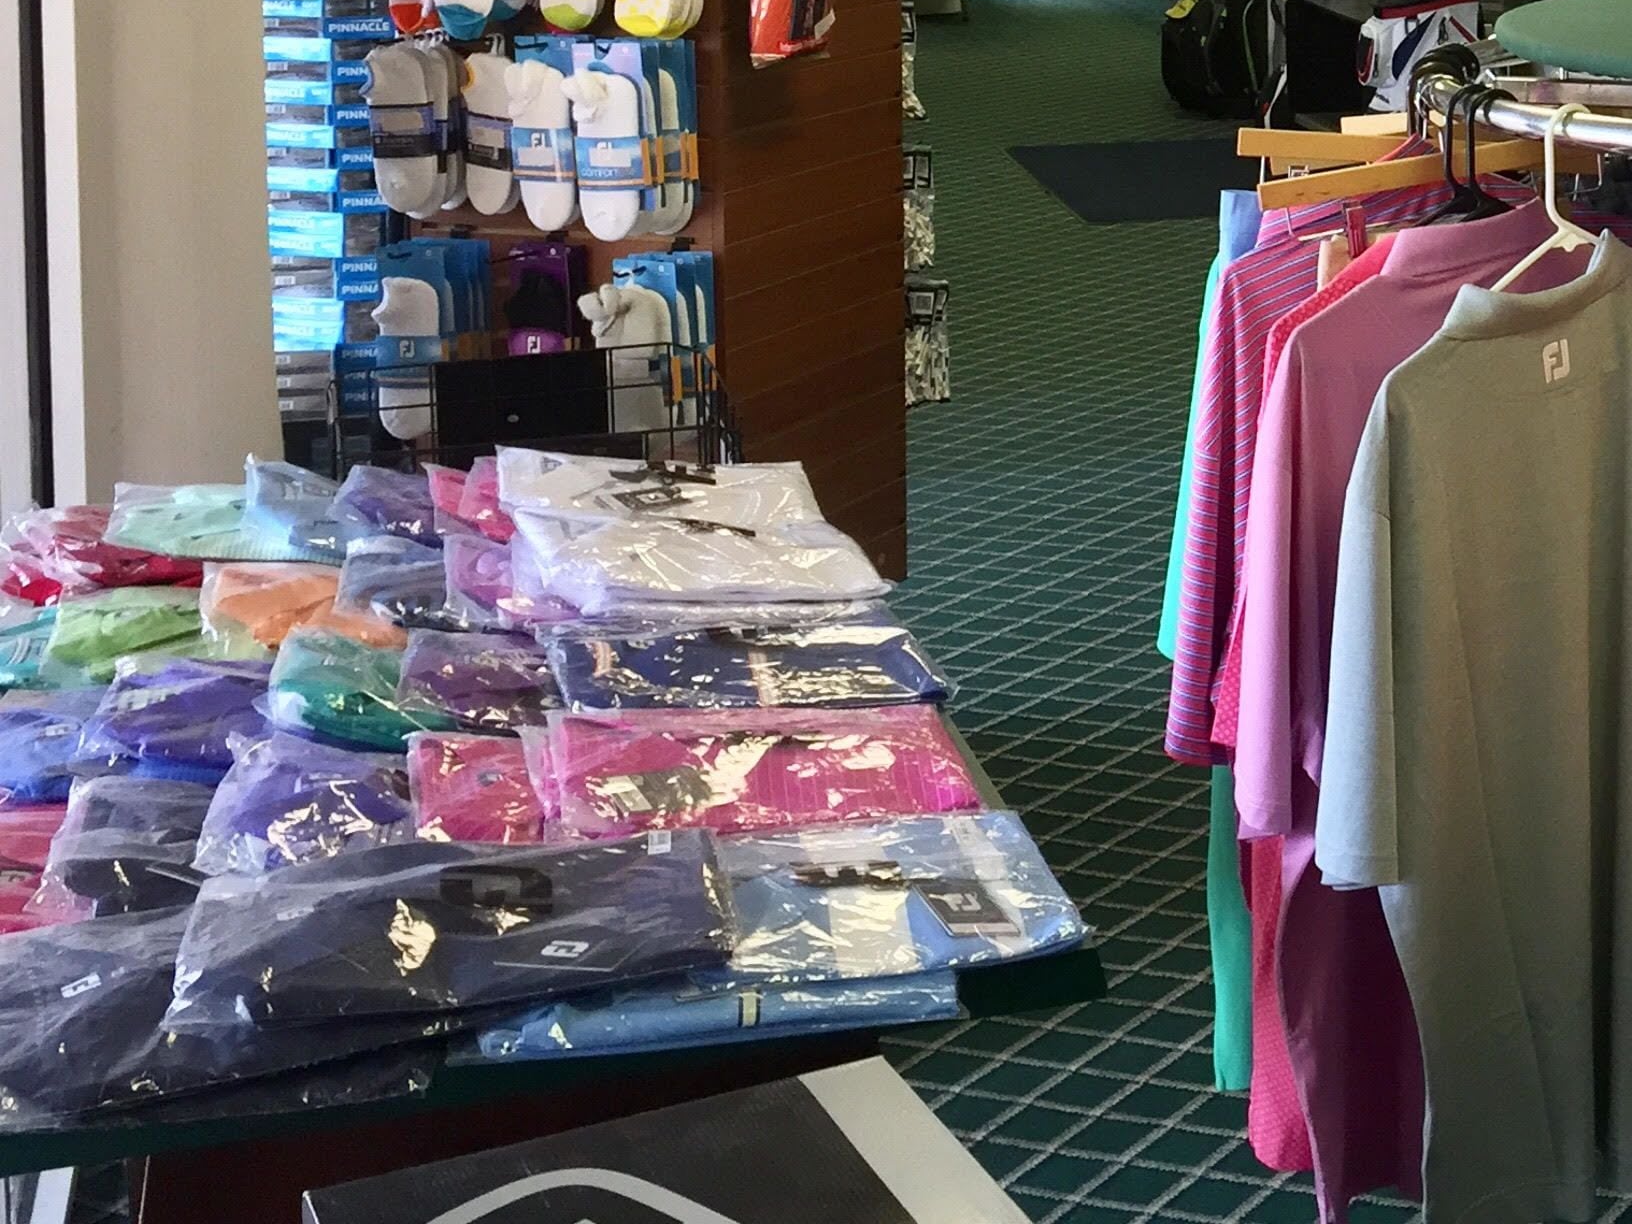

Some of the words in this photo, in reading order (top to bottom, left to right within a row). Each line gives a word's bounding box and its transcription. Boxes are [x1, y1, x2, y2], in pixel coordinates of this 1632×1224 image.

[328, 22, 390, 32] PINNACLE
[400, 340, 414, 359] FJ
[528, 335, 540, 353] FJ
[1542, 338, 1570, 384] FJ
